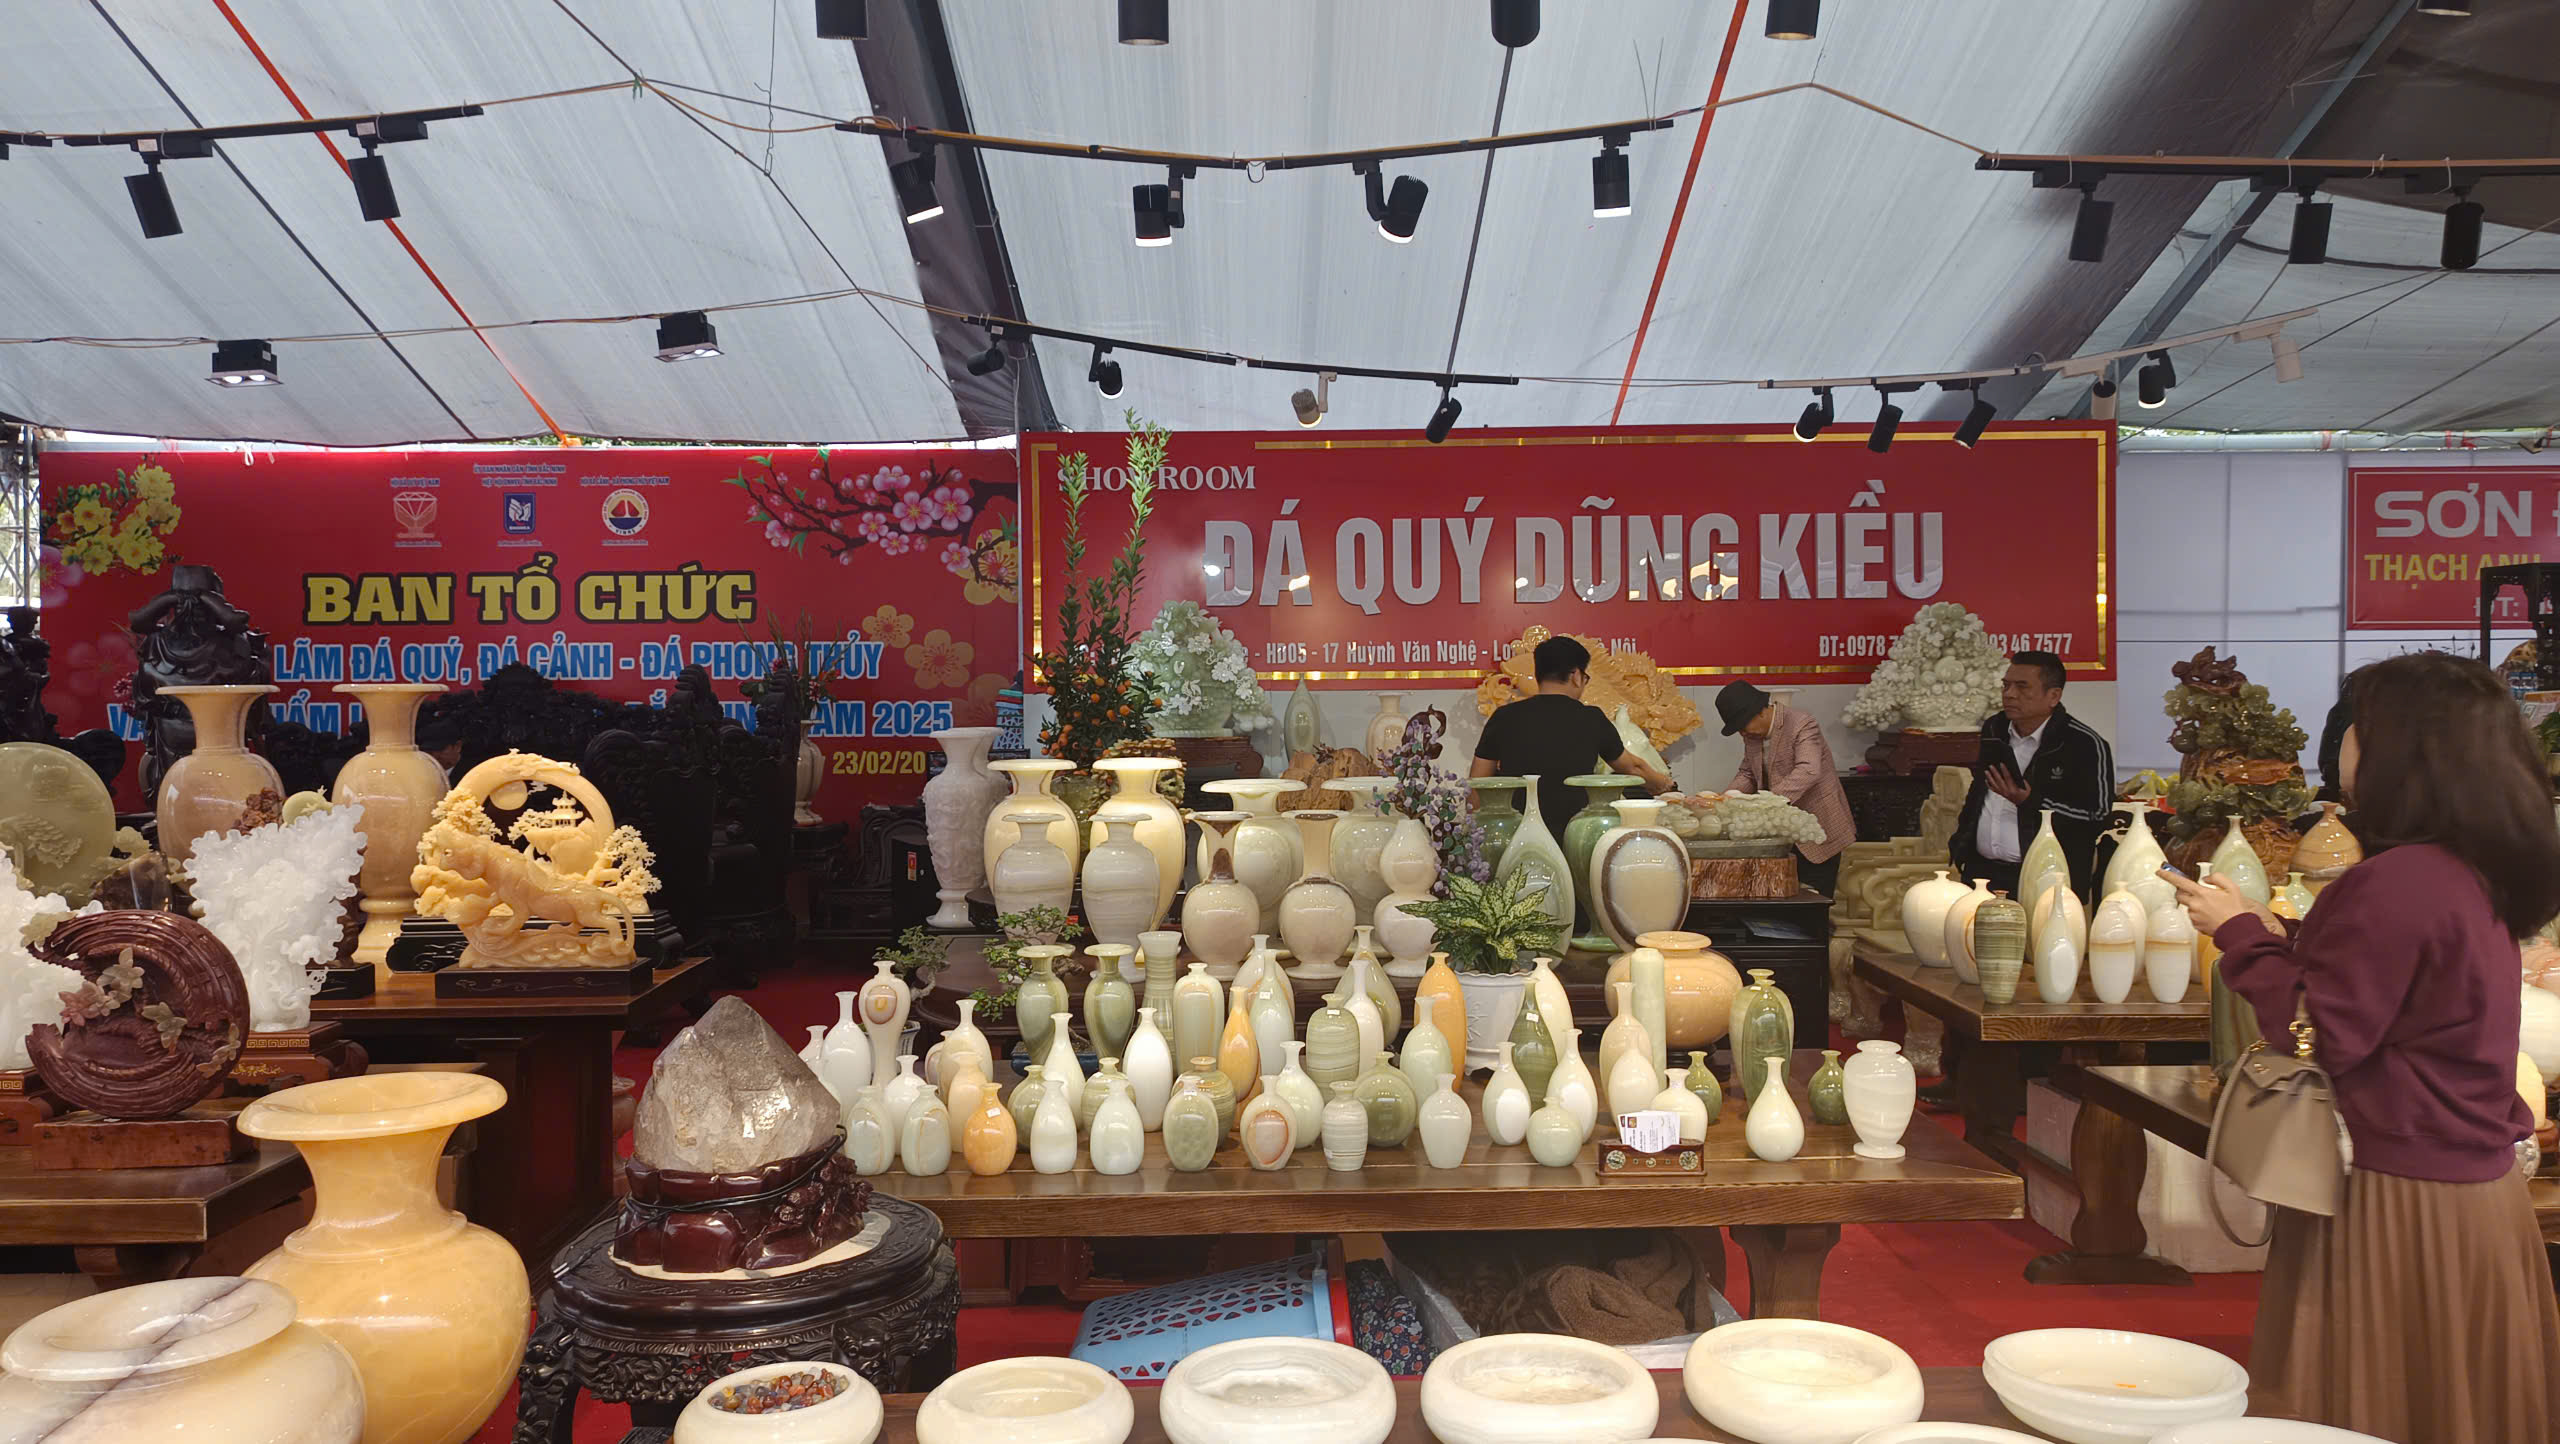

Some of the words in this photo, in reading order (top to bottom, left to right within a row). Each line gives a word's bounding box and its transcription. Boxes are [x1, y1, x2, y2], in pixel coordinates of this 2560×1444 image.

[2374, 482, 2532, 538] SƠN
[1202, 499, 1313, 606] ĐÁ
[1335, 496, 1495, 615] QUÝ
[1515, 495, 1740, 604] DŨNG
[1759, 479, 1944, 600] KIỀU
[304, 574, 454, 624] BAN
[469, 553, 560, 624] TỔ
[578, 562, 756, 623] CHỨC
[2364, 553, 2468, 590] THẠCH
[274, 639, 344, 682] LÃM
[349, 637, 396, 682] ĐÁ
[400, 637, 471, 685] QUÝ,
[527, 631, 613, 680] CẢNH
[640, 635, 684, 680] ĐÁ
[1322, 642, 1339, 664] 17
[1346, 640, 1395, 666] Huỳnh
[1402, 640, 1430, 663] Văn
[1436, 640, 1477, 666] Nghệ
[2033, 633, 2072, 655] 7577
[872, 700, 953, 737] 2025
